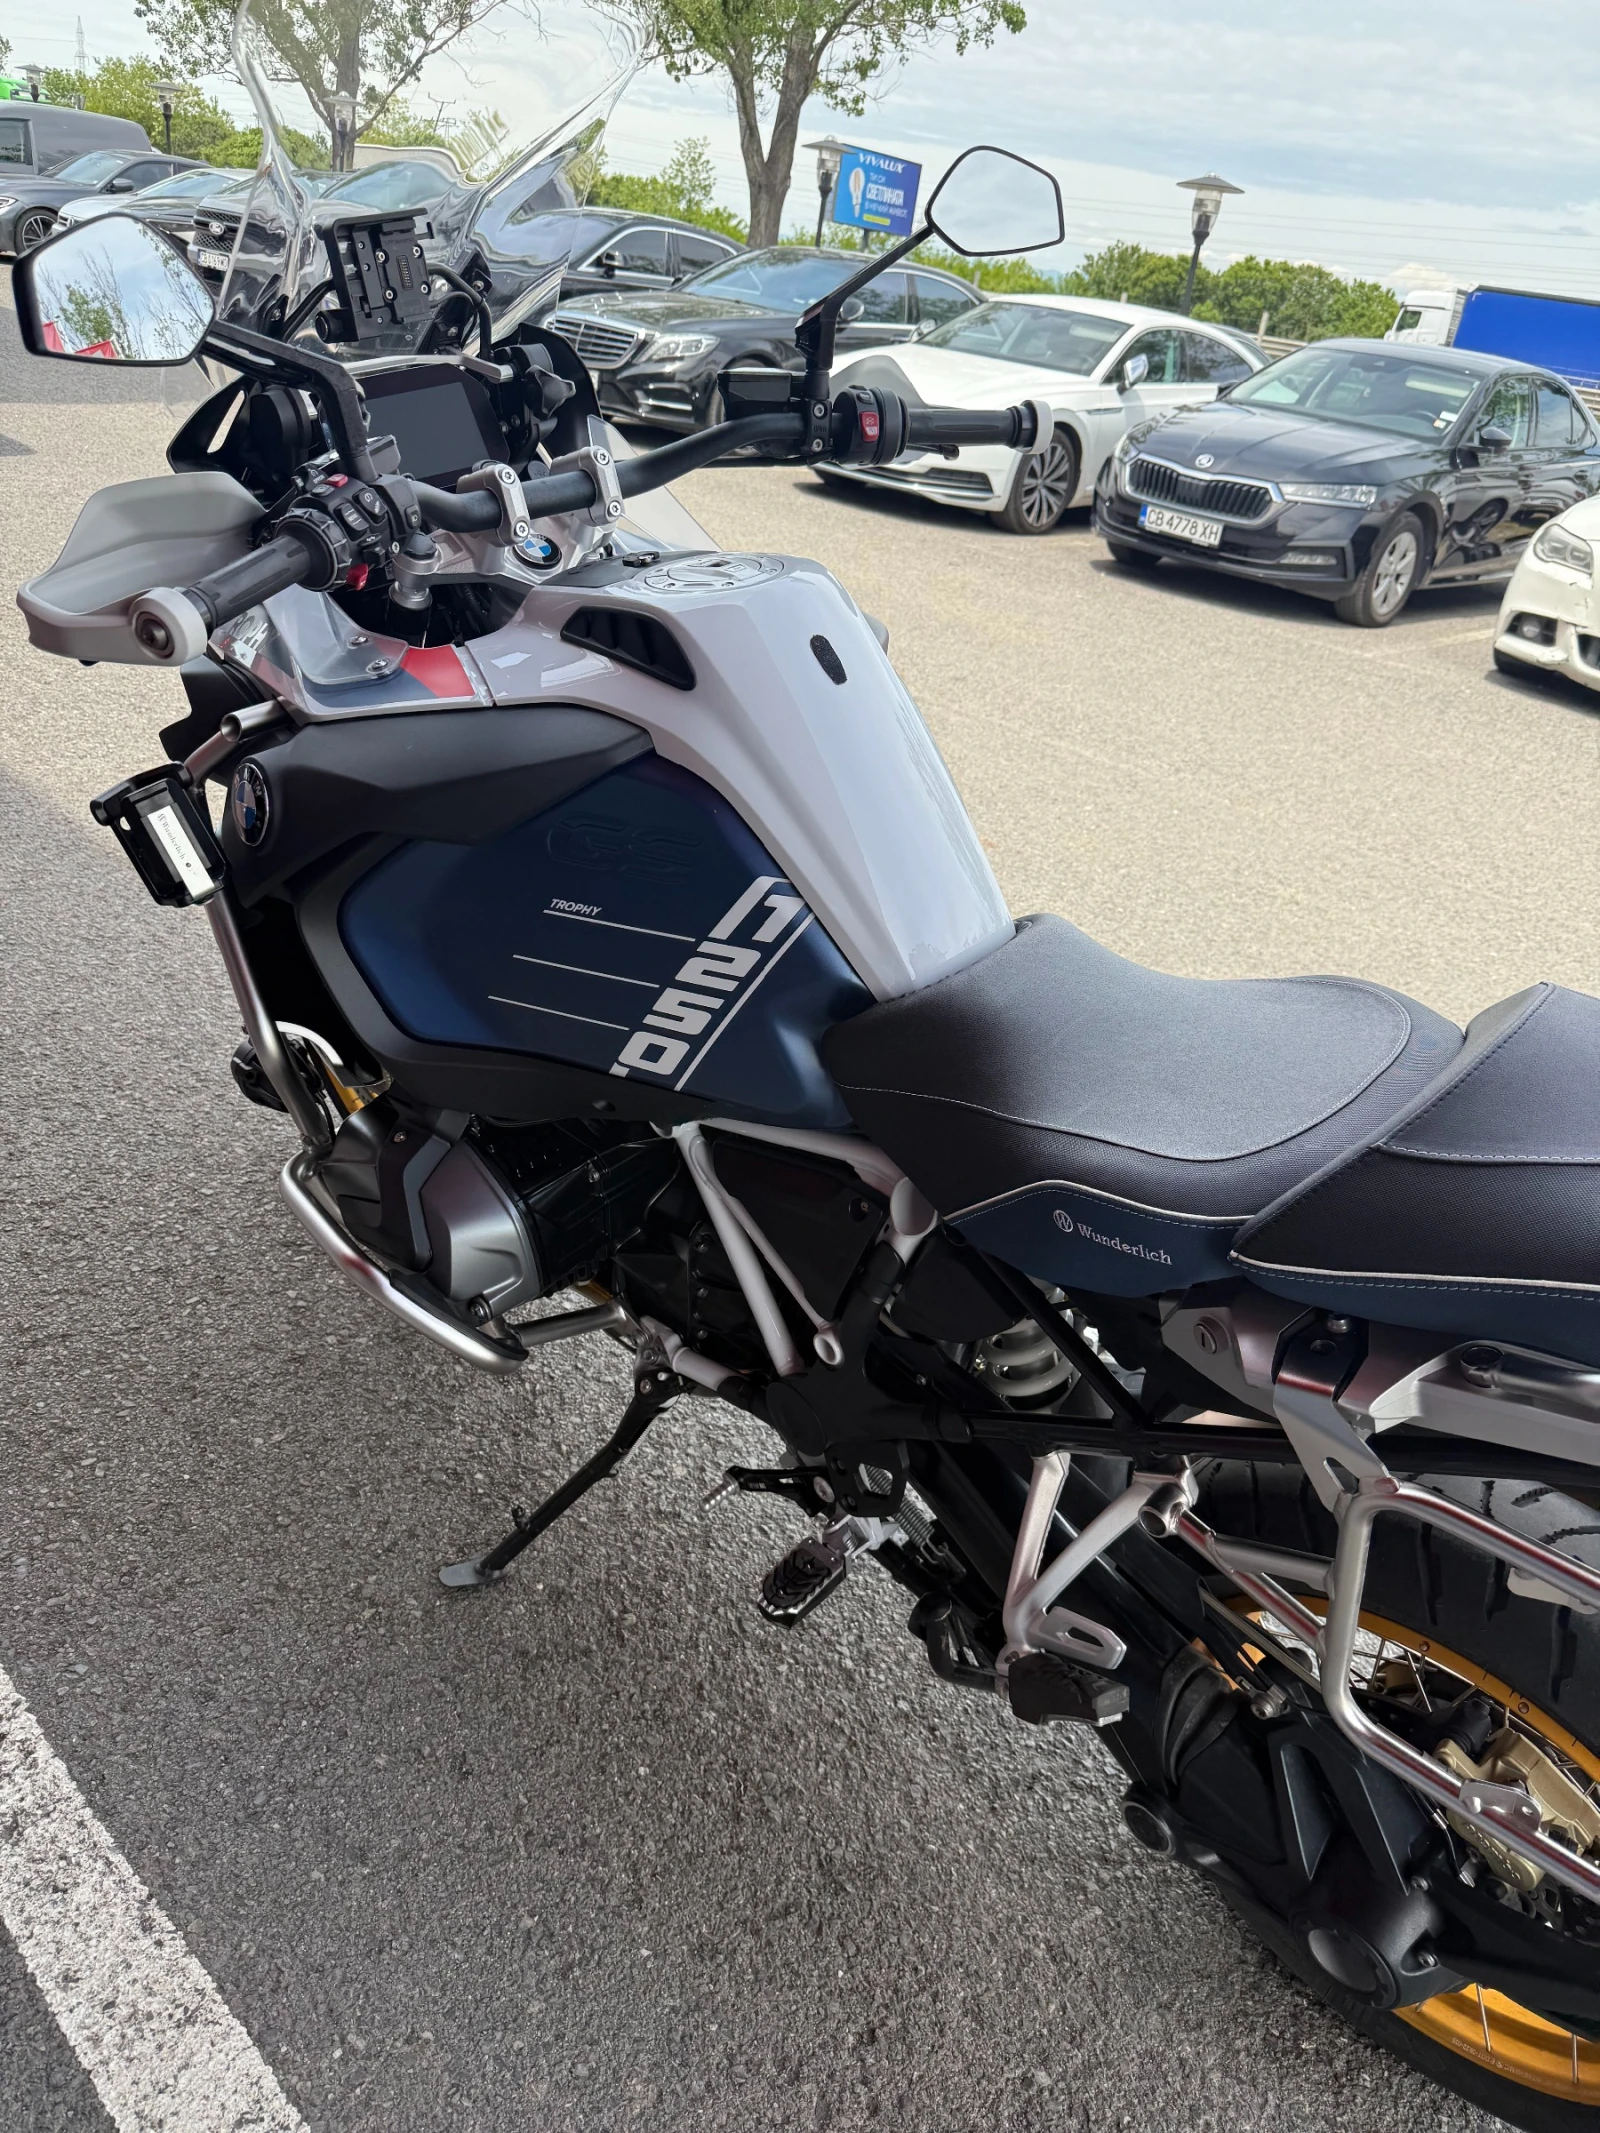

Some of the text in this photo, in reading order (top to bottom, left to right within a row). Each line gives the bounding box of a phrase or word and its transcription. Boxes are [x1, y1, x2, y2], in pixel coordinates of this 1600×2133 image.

[859, 153, 905, 174] VIVALUX
[1147, 509, 1220, 542] CB 4778 XH
[161, 820, 186, 860] Wunderlich
[549, 898, 603, 917] TROPHY
[617, 893, 807, 1076] 1250
[1076, 1222, 1173, 1266] Wunderlich
